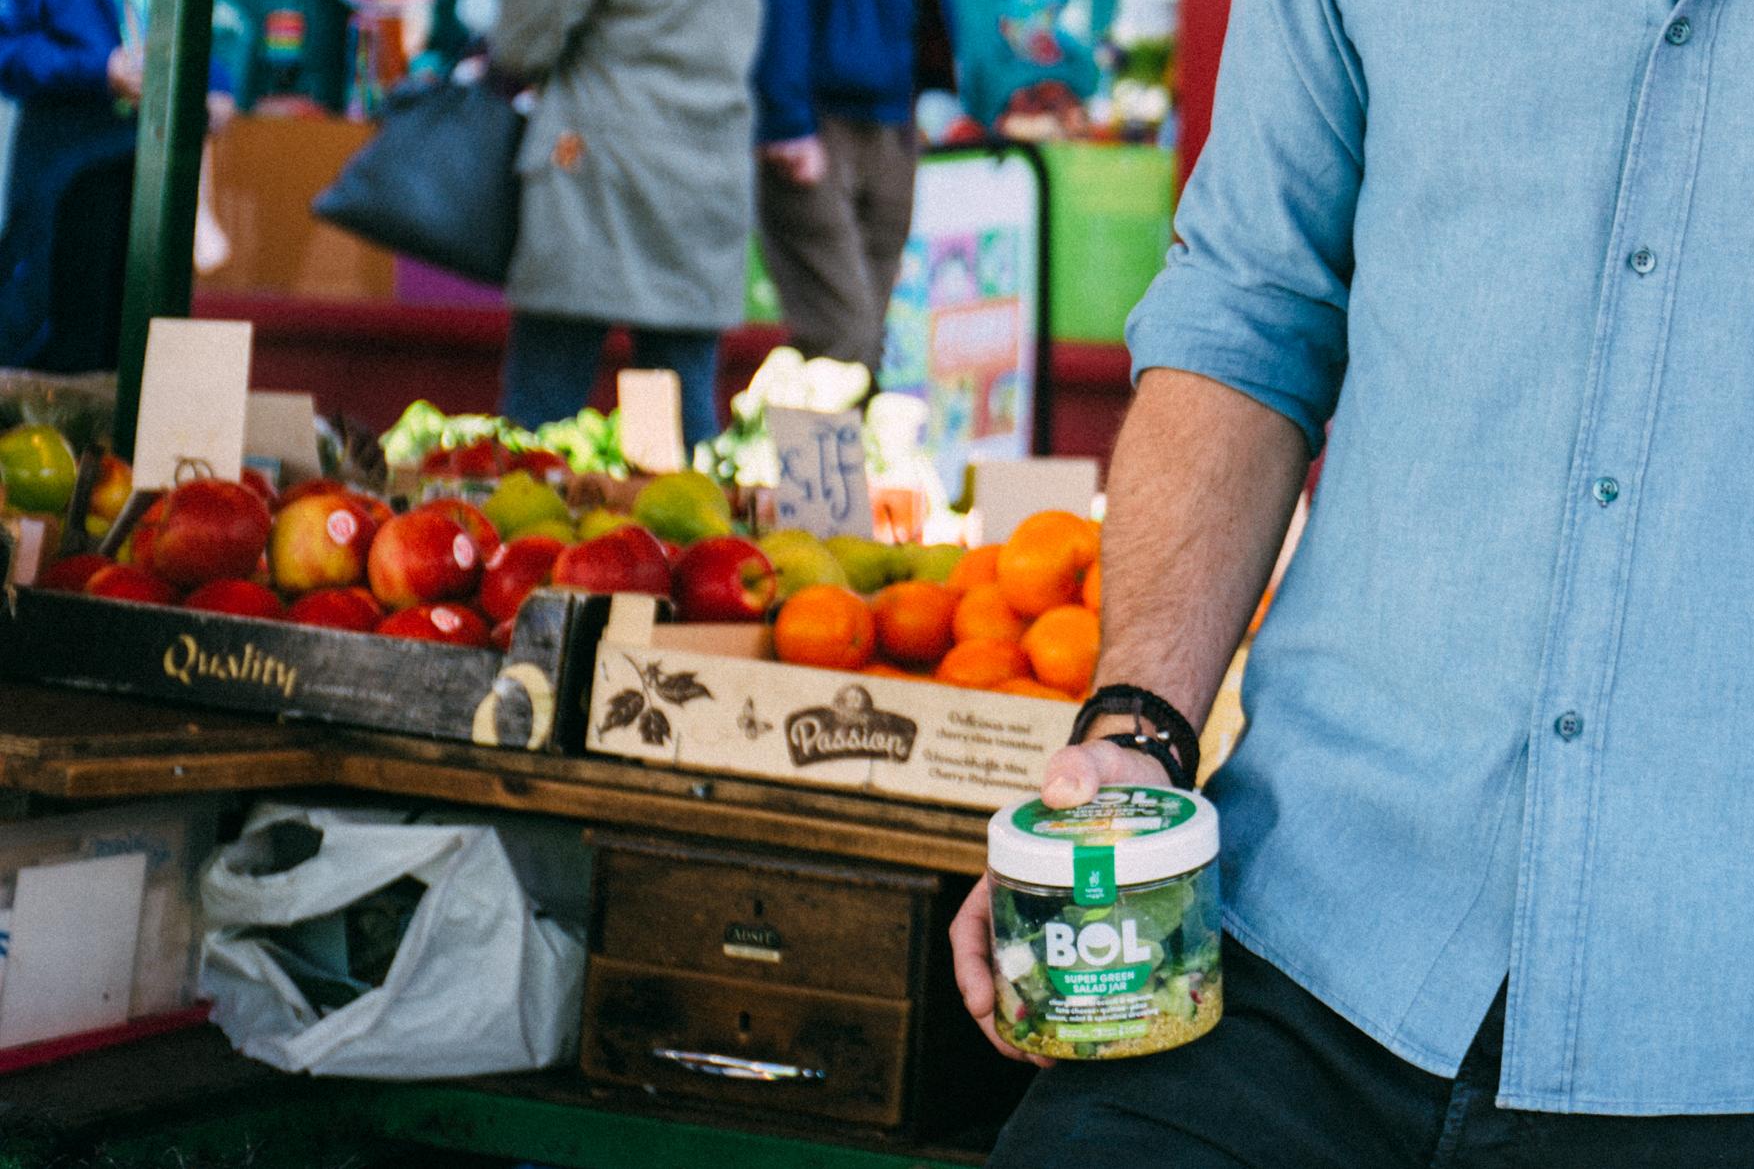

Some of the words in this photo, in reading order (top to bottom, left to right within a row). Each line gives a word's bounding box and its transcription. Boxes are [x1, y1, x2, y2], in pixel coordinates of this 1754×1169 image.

[163, 634, 298, 698] Quality
[791, 715, 907, 759] Passion
[1045, 918, 1152, 967] BOL
[1064, 973, 1097, 984] SUPER
[1099, 970, 1135, 983] GREEN
[1073, 983, 1107, 993] SALAD
[1108, 981, 1127, 994] JAR
